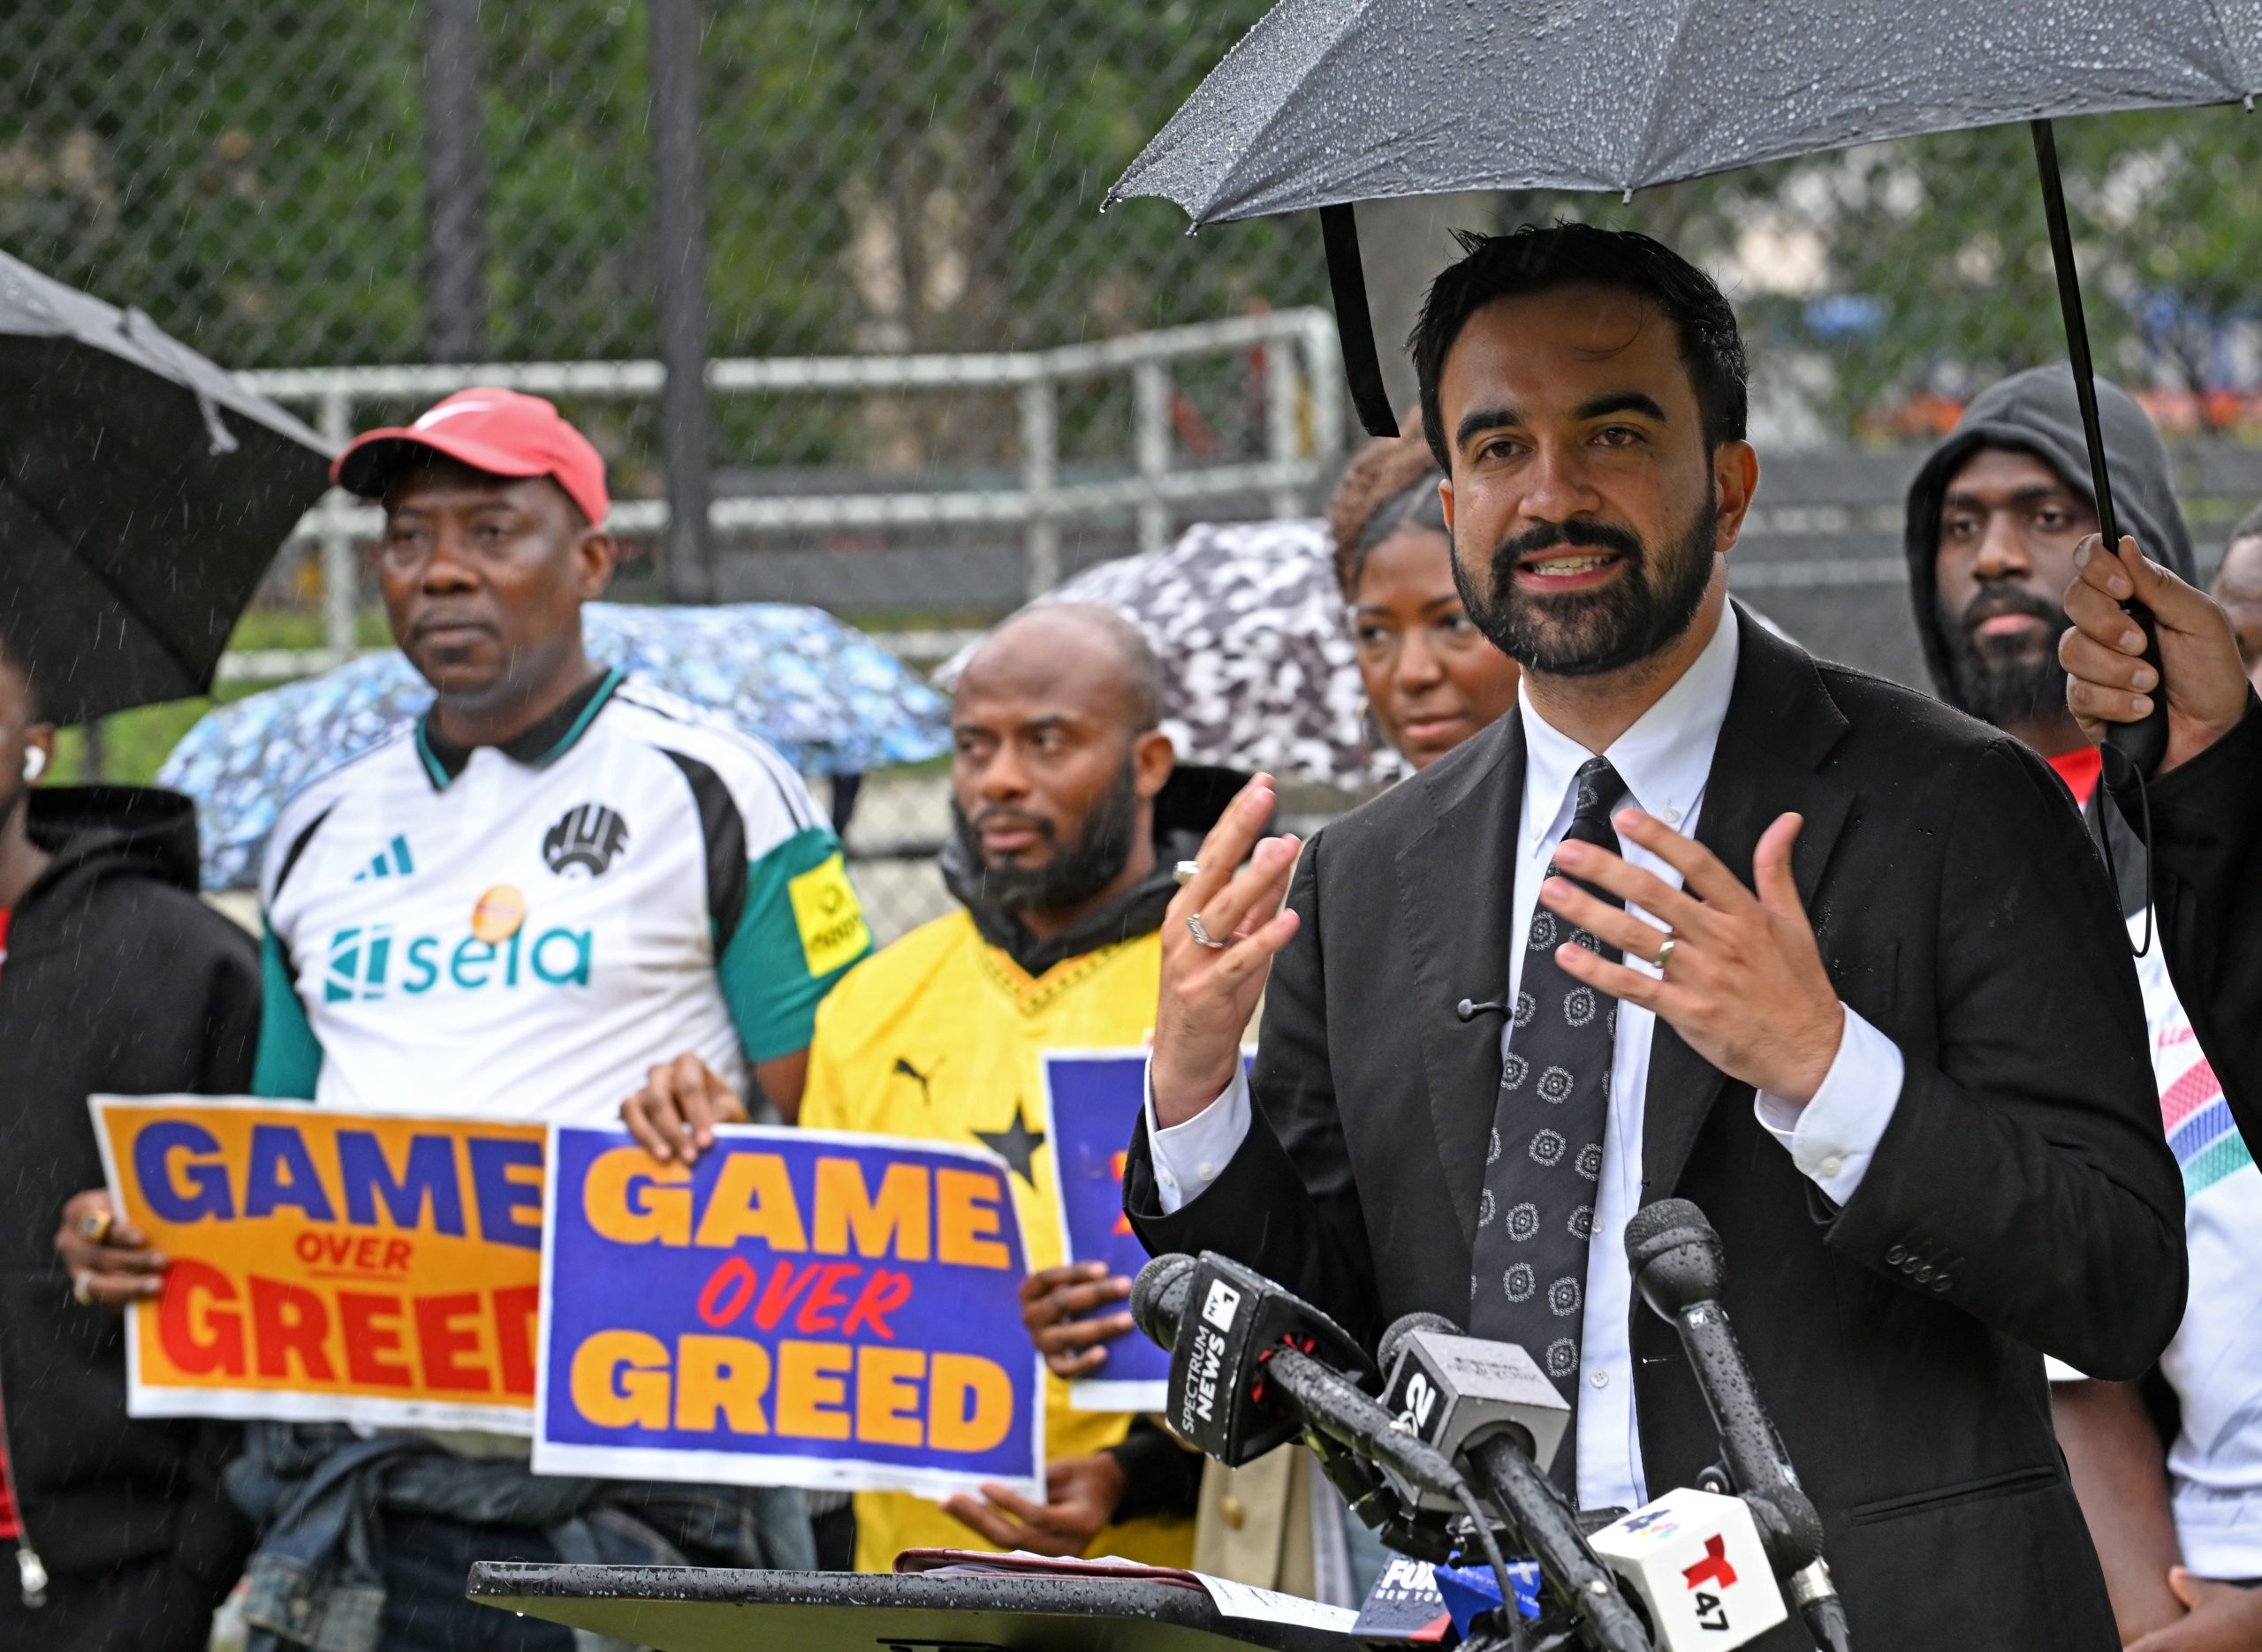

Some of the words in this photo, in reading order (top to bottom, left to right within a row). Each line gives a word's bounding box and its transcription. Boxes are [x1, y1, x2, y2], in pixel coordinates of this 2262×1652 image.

[402, 923, 593, 995] sela
[134, 1120, 543, 1252] GAME
[585, 1147, 1011, 1269] GAME
[294, 1231, 414, 1271] OVER
[697, 1255, 913, 1339] OVER
[1207, 1294, 1219, 1318] NY
[571, 1330, 1013, 1452] GREED
[1181, 1324, 1211, 1435] SPECTRUM
[1196, 1331, 1226, 1422] NEWS
[1405, 1372, 1438, 1428] 2
[1375, 1588, 1410, 1601] NEW
[1414, 1591, 1443, 1603] YOR
[1380, 1558, 1438, 1591] FOX
[1695, 1591, 1730, 1631] 47
